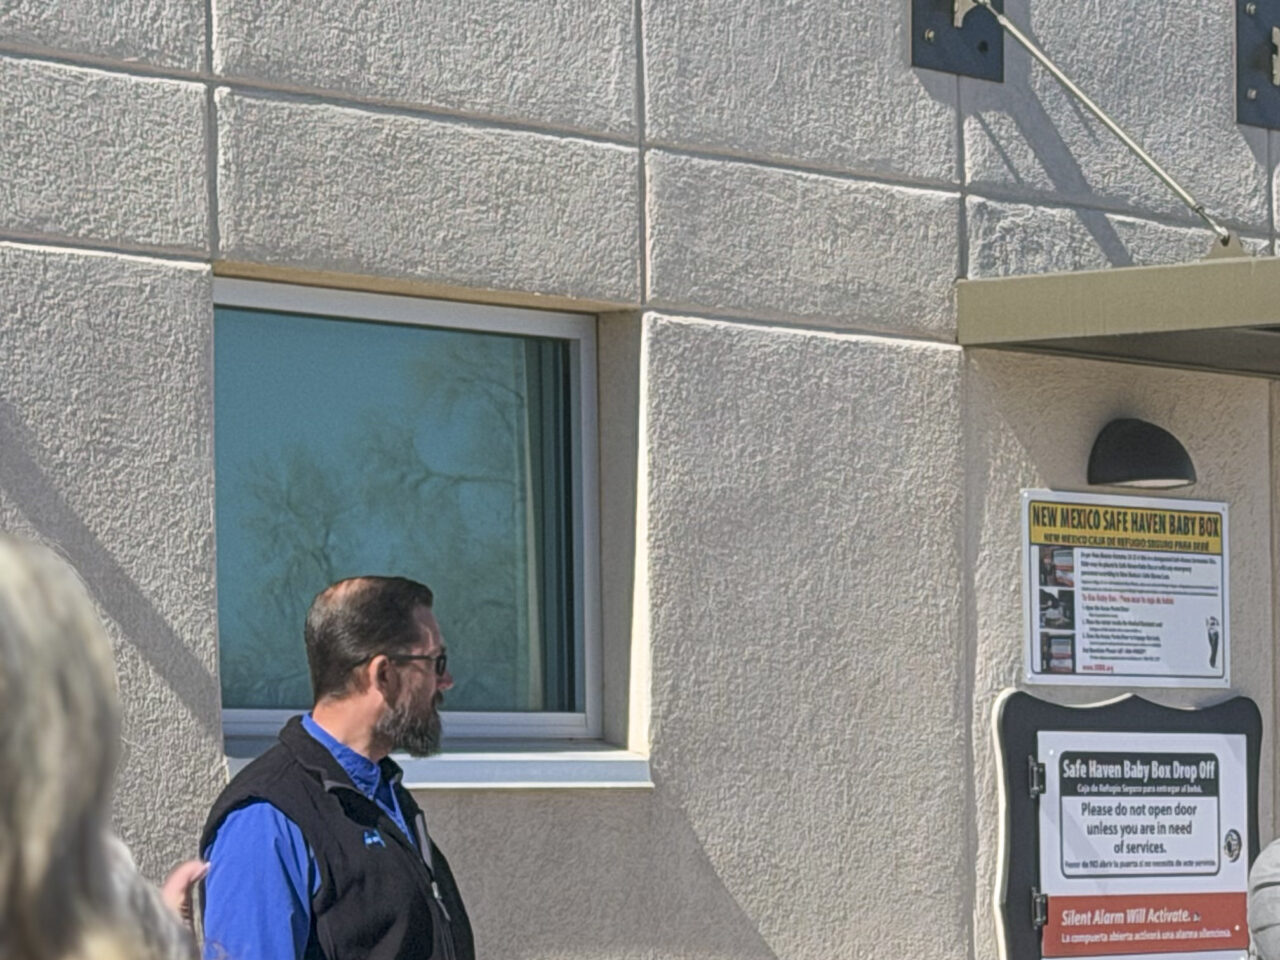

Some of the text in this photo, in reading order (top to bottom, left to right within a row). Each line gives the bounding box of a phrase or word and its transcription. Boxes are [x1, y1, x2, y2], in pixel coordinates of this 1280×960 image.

[1032, 505, 1219, 537] NEW MEXICO SAFE HAVEN BABY BOX
[1063, 759, 1216, 784] Safe Haven Baby Box Drop Off
[1081, 801, 1197, 820] Please do not open door
[1087, 820, 1192, 838] unless you are in need
[1114, 839, 1167, 854] of services.
[1061, 907, 1191, 926] Silent Alarm Will Activate.
